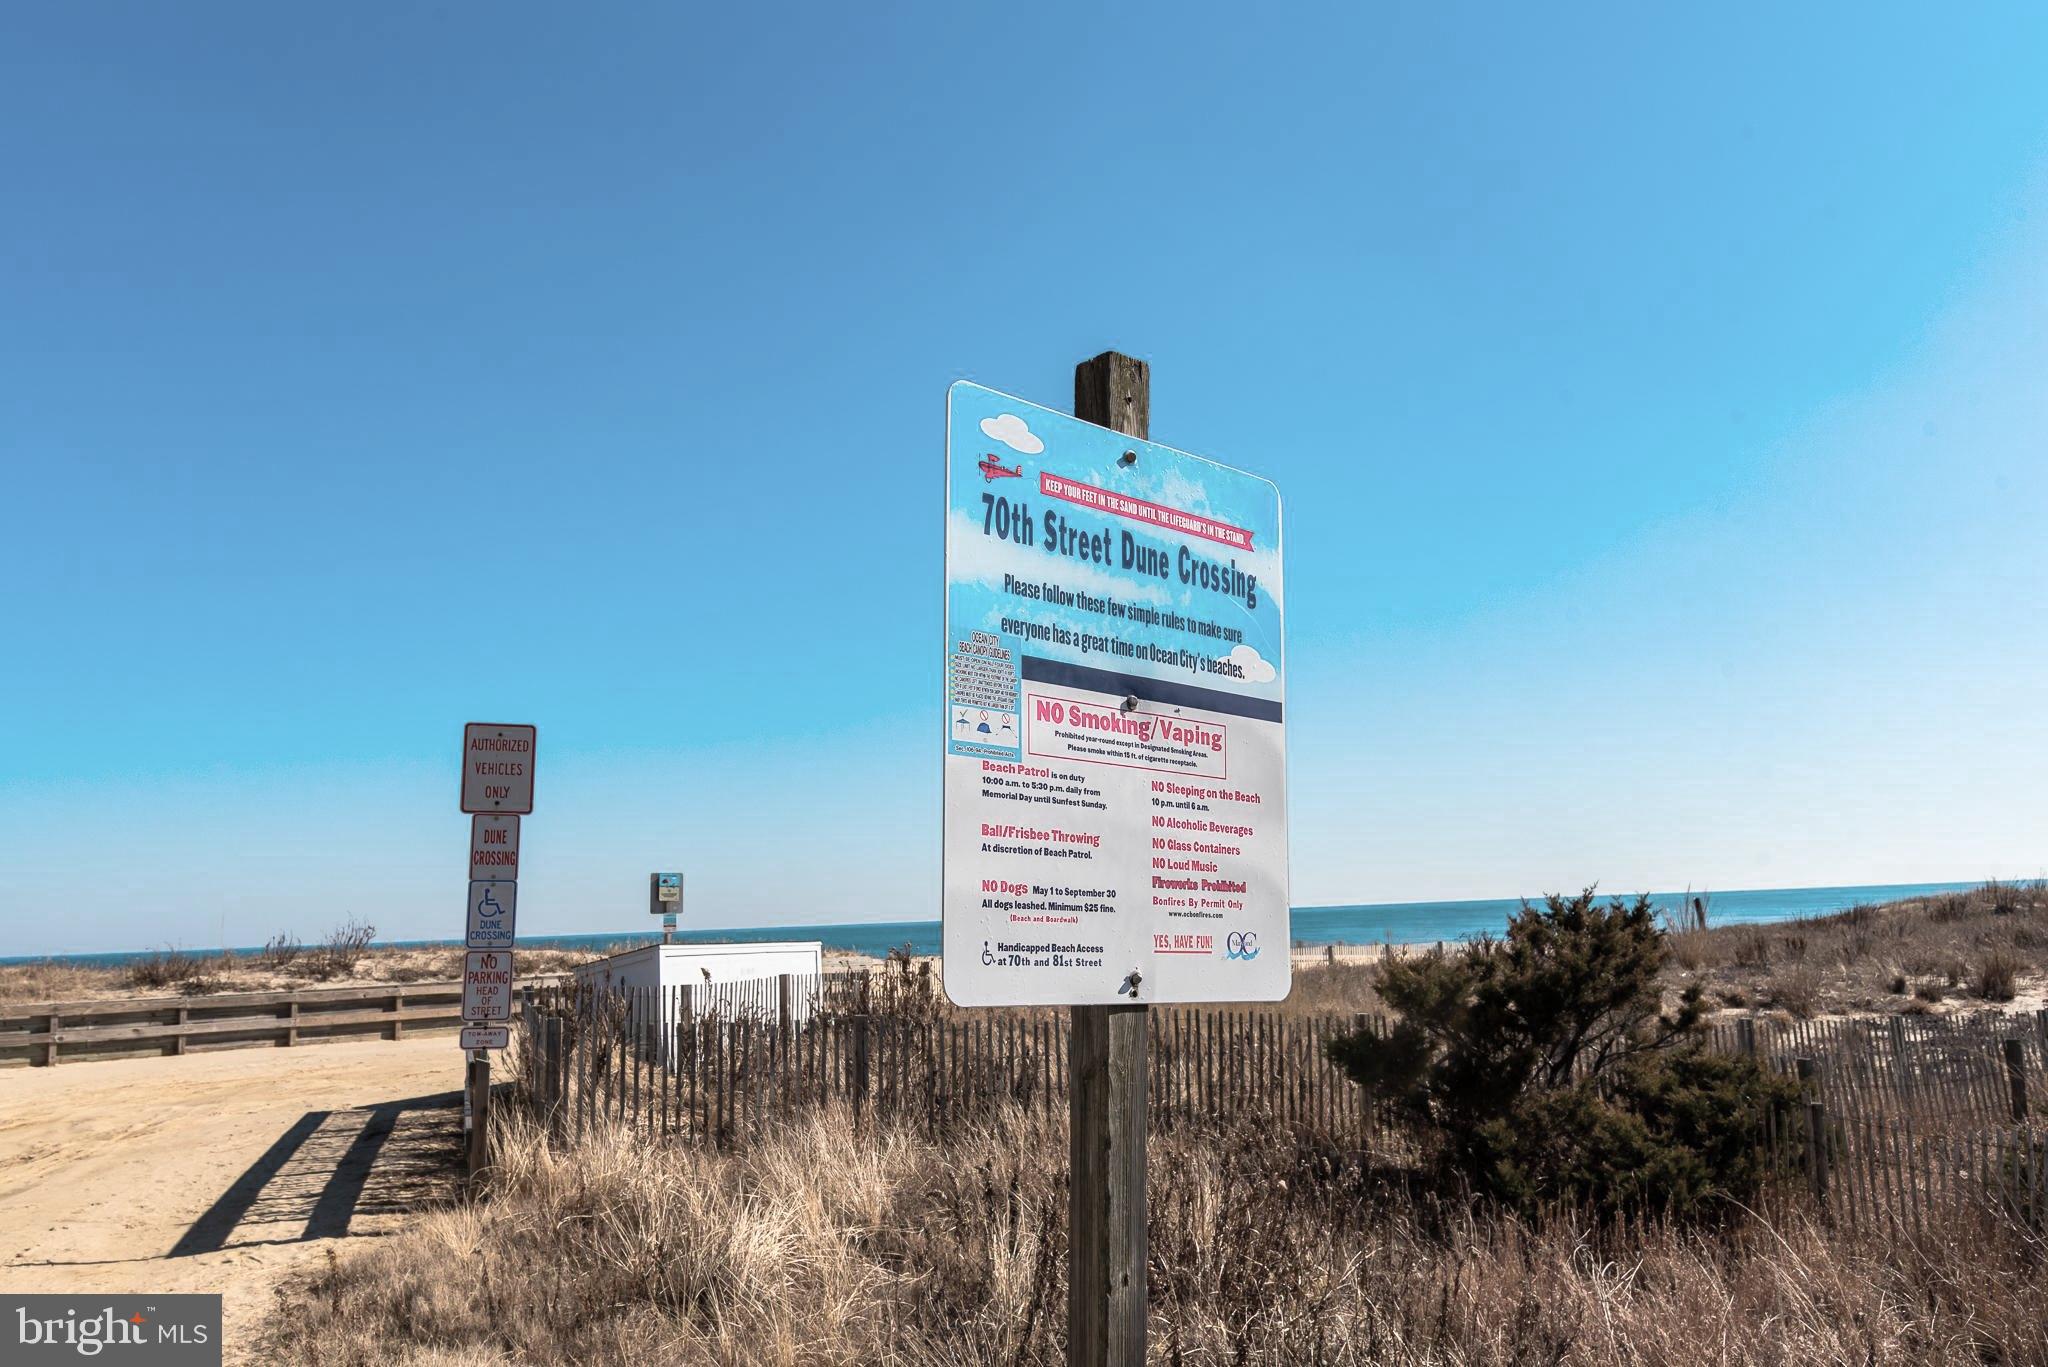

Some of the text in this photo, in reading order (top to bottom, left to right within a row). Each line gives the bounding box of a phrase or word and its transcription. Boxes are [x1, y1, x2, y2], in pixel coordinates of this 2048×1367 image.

[1045, 478, 1246, 546] KEEP YOUR FEET IN THE SAND UNTIL THE LIFEGUARD'S IN THE STAND.
[981, 492, 1257, 610] 70th Street Dune Crossing
[1004, 572, 1243, 644] Please follow these few simple rules to make sure
[1001, 617, 1246, 680] everyone has a great time on Ocean City's beaches.
[1037, 699, 1222, 752] NO Smoking/Vaping
[470, 737, 530, 754] AUTHORIZED
[1054, 730, 1085, 741] Prohibited
[1085, 736, 1116, 746] year-round
[1116, 740, 1134, 749] except
[1140, 742, 1170, 754] Designated
[1170, 747, 1193, 758] Smoking
[1193, 750, 1209, 759] Areas.
[1067, 743, 1087, 753] Please
[1087, 747, 1106, 756] smoke
[1106, 750, 1123, 758] within
[1123, 751, 1131, 759] 15
[1138, 753, 1144, 761] of
[1144, 756, 1169, 765] cigarette
[1169, 758, 1198, 768] receptacle.
[475, 761, 523, 777] VEHICLES
[982, 759, 1086, 784] Beach Patrol is on duty
[485, 785, 511, 800] ONLY
[982, 776, 1101, 796] 10:00 a.m. to 5:30 p.m. daily from
[1152, 780, 1261, 804] NO Sleeping on the Beach
[982, 789, 1108, 811] Memorial Day until Sunfest Sunday.
[1152, 797, 1210, 812] 10 p.m. until 6 a.m.
[1152, 815, 1254, 838] NO Alcoholic Beverages
[483, 829, 508, 845] DUNE
[981, 823, 1101, 848] Ball/Frisbee Throwing
[981, 843, 1093, 860] At discretion of Beach Patrol.
[1152, 837, 1241, 856] NO Glass Containers
[473, 849, 517, 867] CROSSING
[1152, 857, 1218, 873] NO Loud Music
[981, 880, 1116, 899] NO Dogs May 1 to September 30
[1152, 875, 1247, 893] Fireworks Prohibited
[982, 899, 1116, 914] All dogs leashed. Minimum $25 fine.
[1152, 895, 1243, 911] Bonfires By Permit Only
[1010, 914, 1079, 925] (Beach and Boardwalk)
[1168, 910, 1224, 919] www.ocbonfires.com
[479, 920, 503, 930] DUNE
[469, 929, 512, 941] CROSSING
[1153, 934, 1213, 950] YES, HAVE FUN!
[997, 942, 1104, 955] Handicapped Beach Access
[480, 956, 498, 970] NO
[997, 954, 1102, 967] at 70th and 81st Street
[467, 971, 509, 985] PARKING
[476, 986, 499, 996] HEAD
[481, 996, 493, 1006] OF
[471, 1006, 502, 1016] STREET
